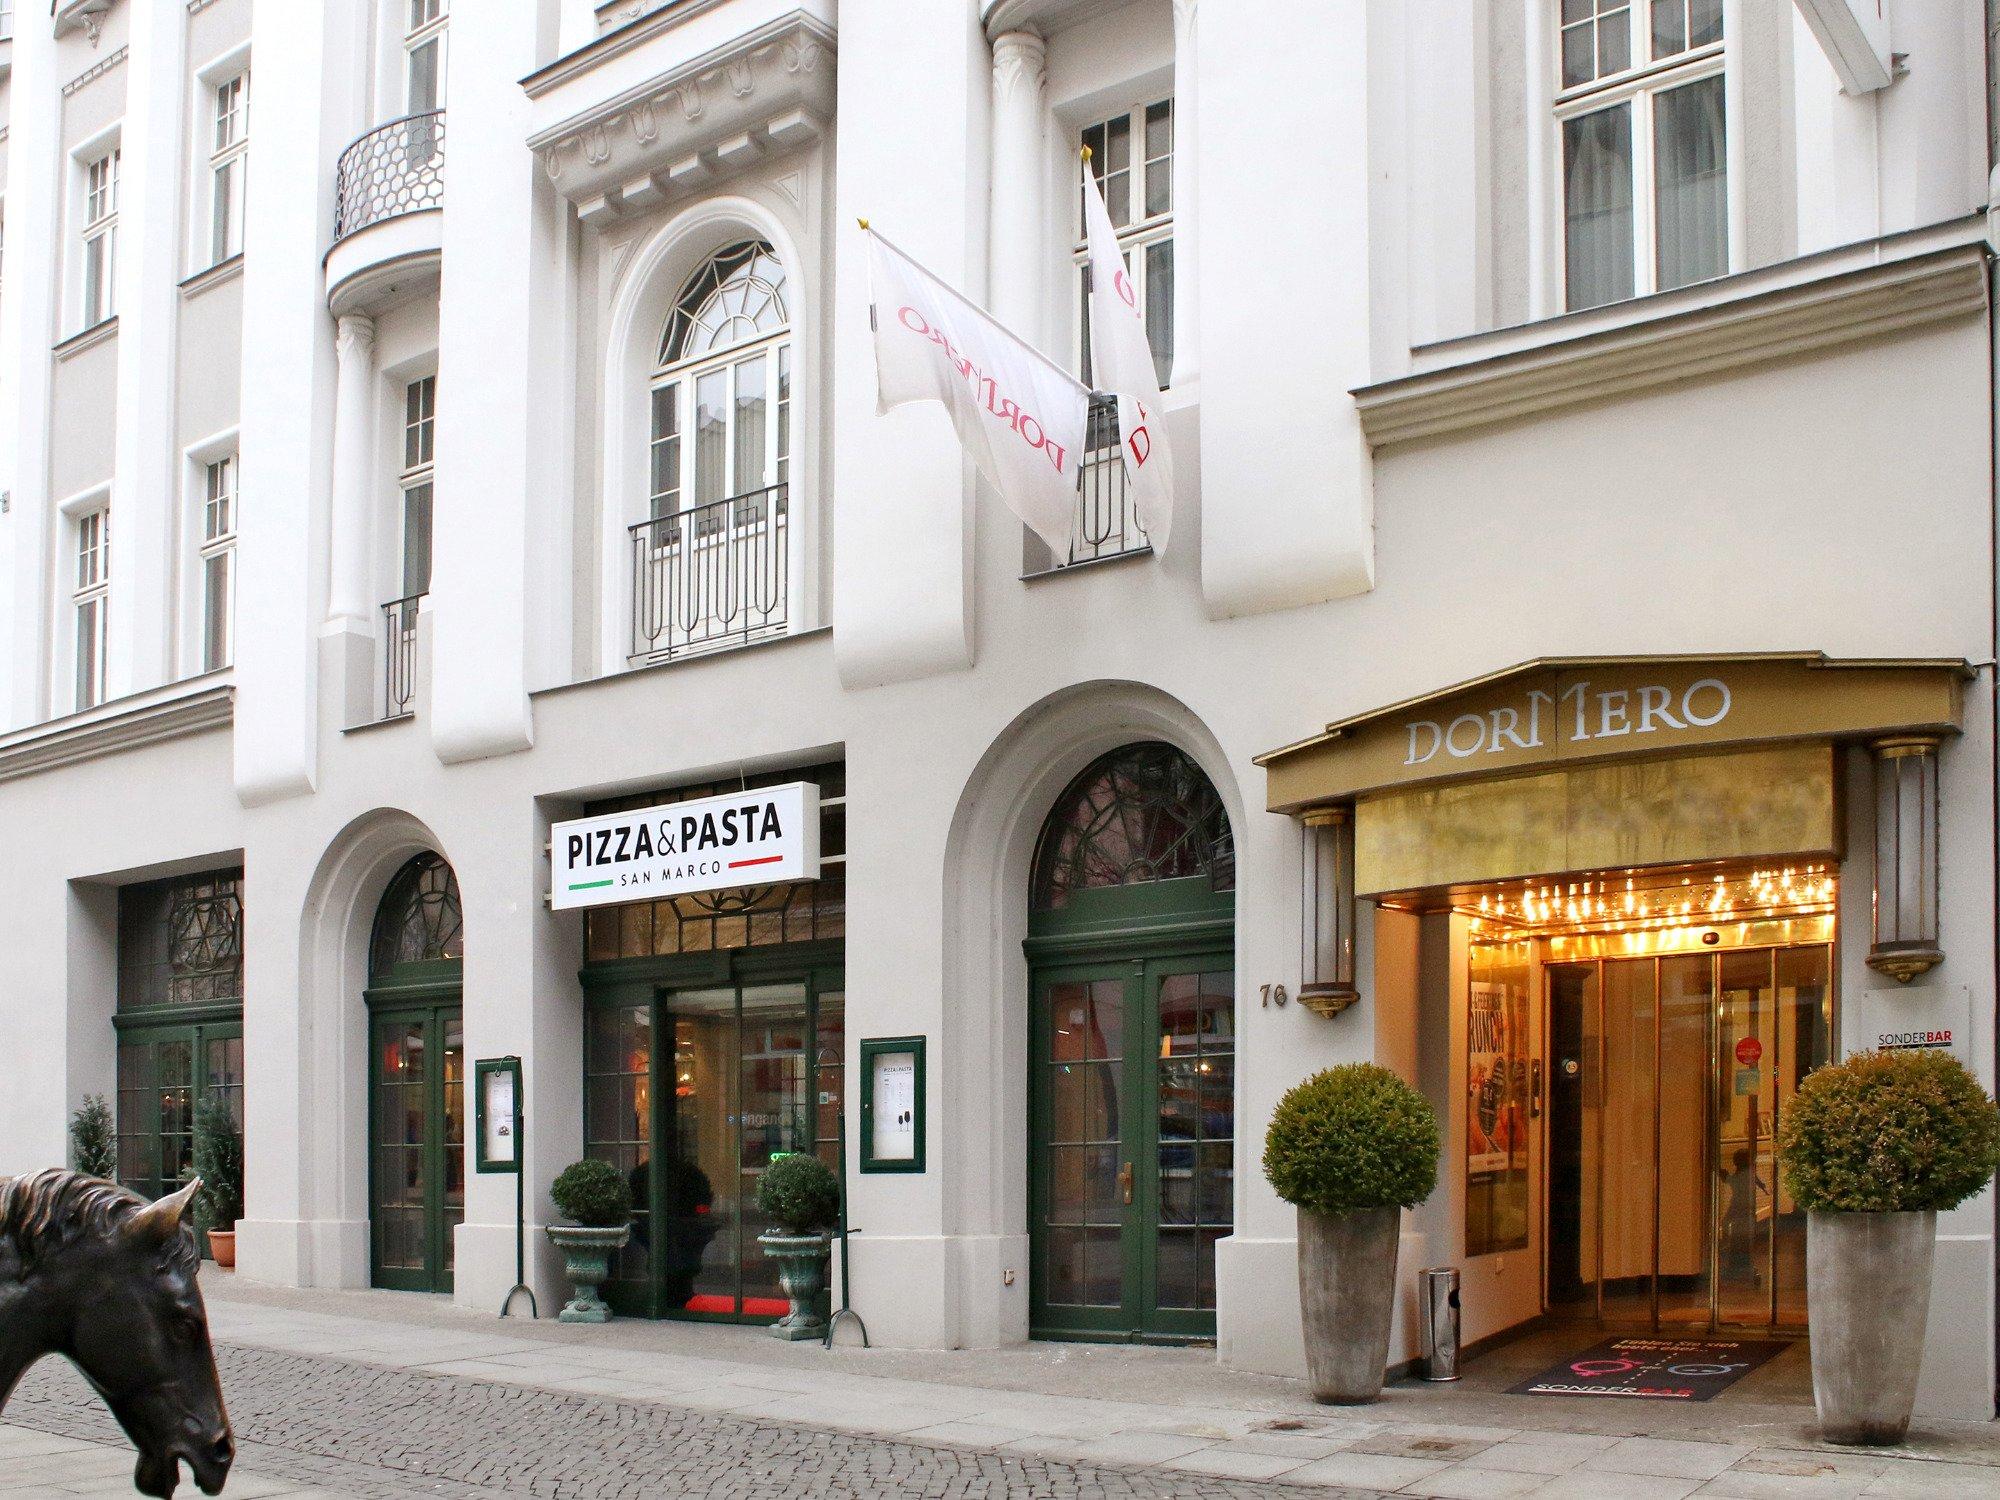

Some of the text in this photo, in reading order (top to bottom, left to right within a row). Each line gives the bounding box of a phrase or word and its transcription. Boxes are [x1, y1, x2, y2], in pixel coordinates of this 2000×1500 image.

[1403, 678, 1732, 765] DORMERO
[621, 860, 721, 887] SAN MARCO
[1259, 983, 1288, 1008] 76
[1878, 1030, 1952, 1046] SONDERBAR
